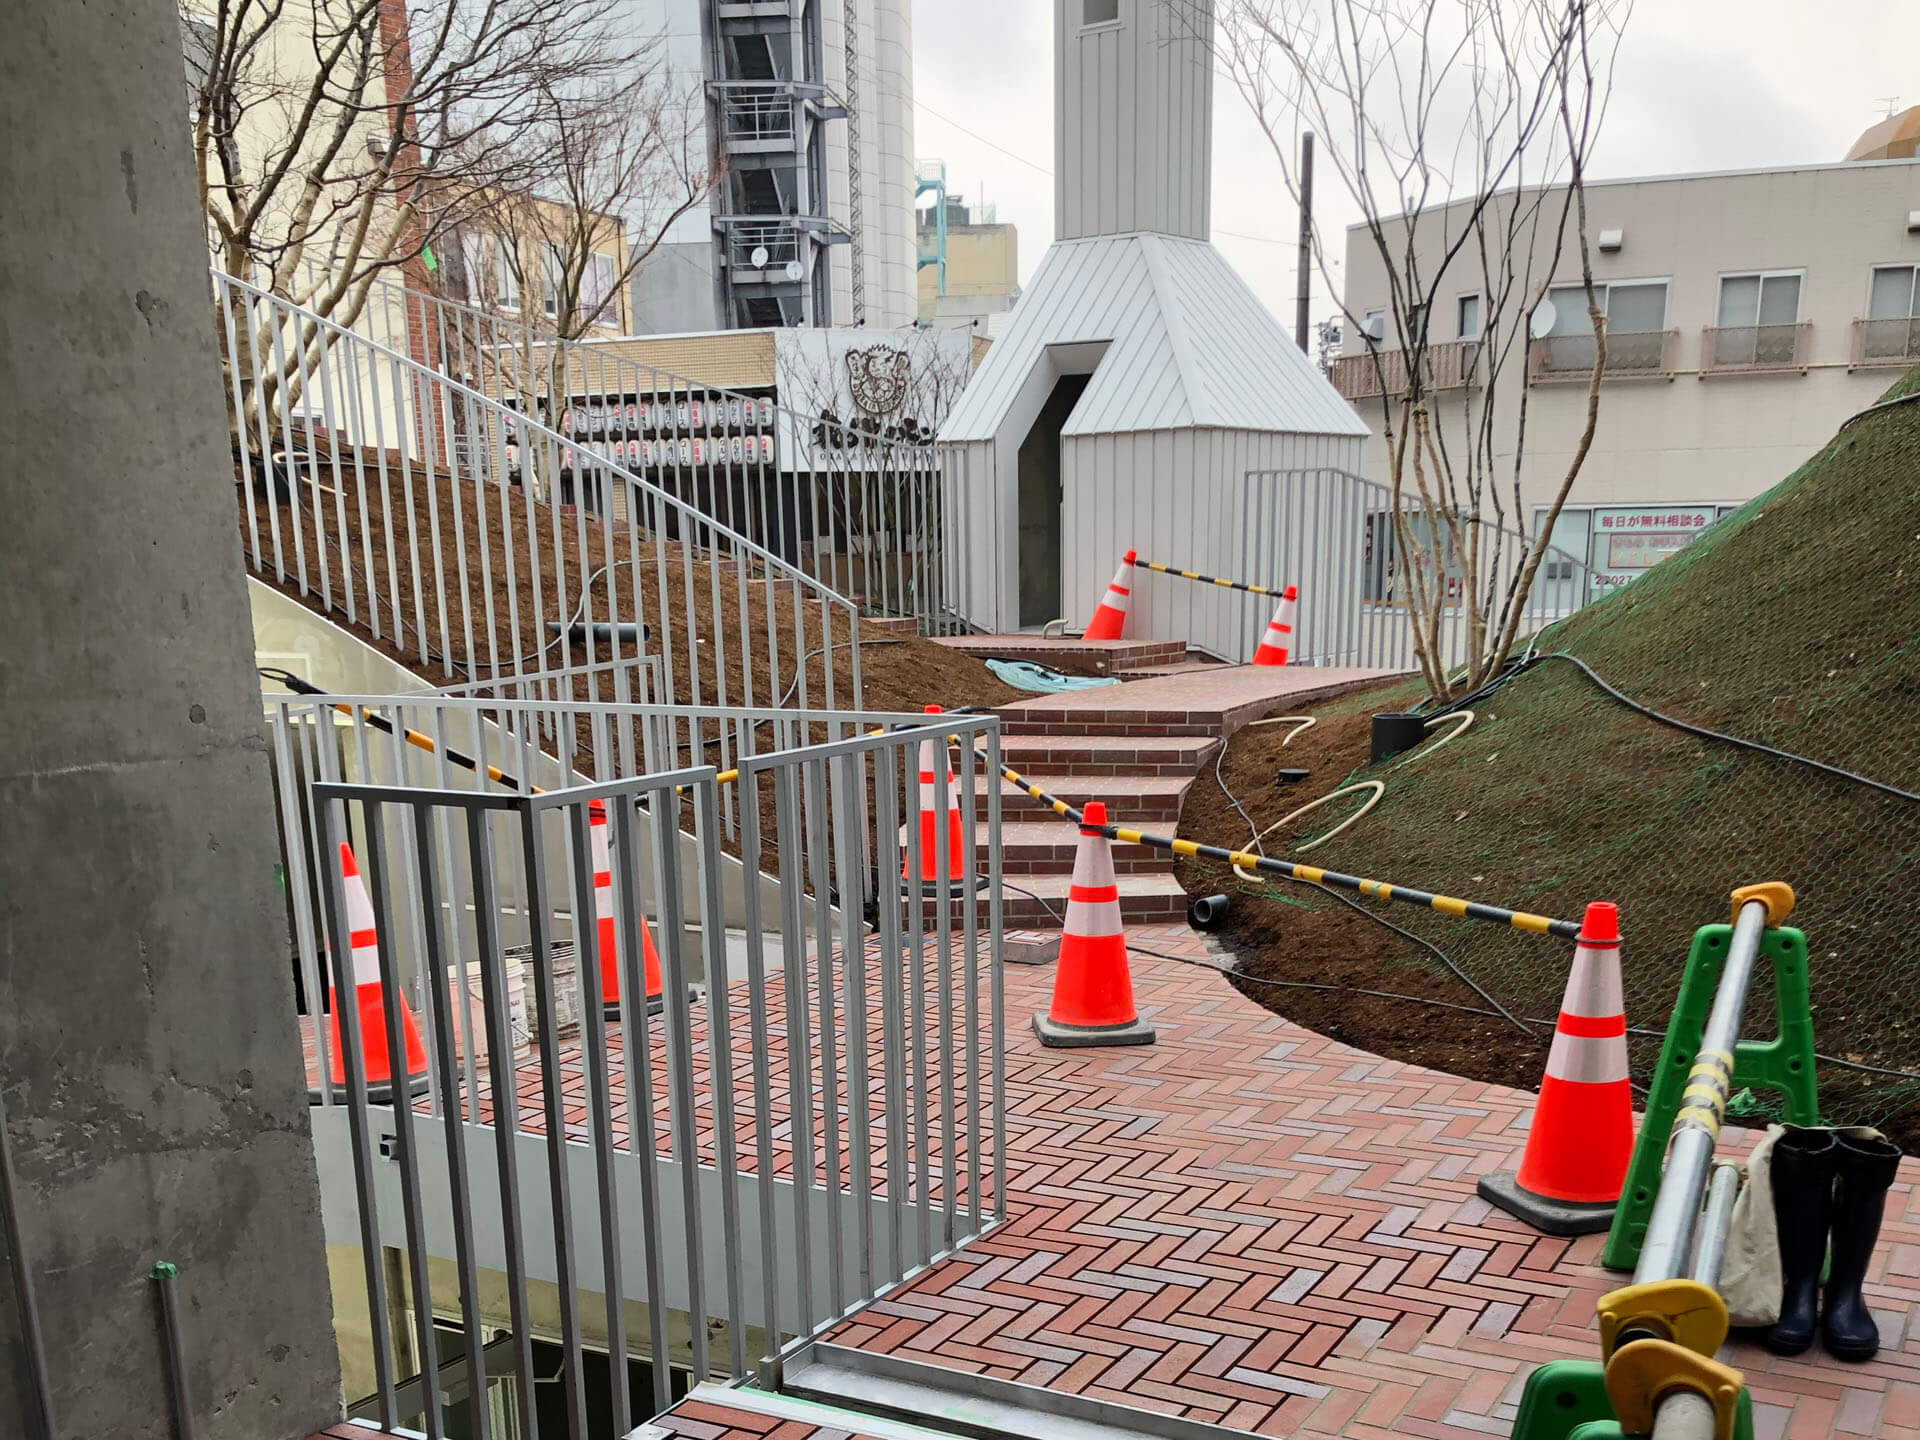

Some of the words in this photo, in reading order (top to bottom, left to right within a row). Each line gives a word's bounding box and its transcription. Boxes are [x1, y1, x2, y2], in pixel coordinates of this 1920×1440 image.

[1602, 514, 1706, 528] 毎日が無料相談会
